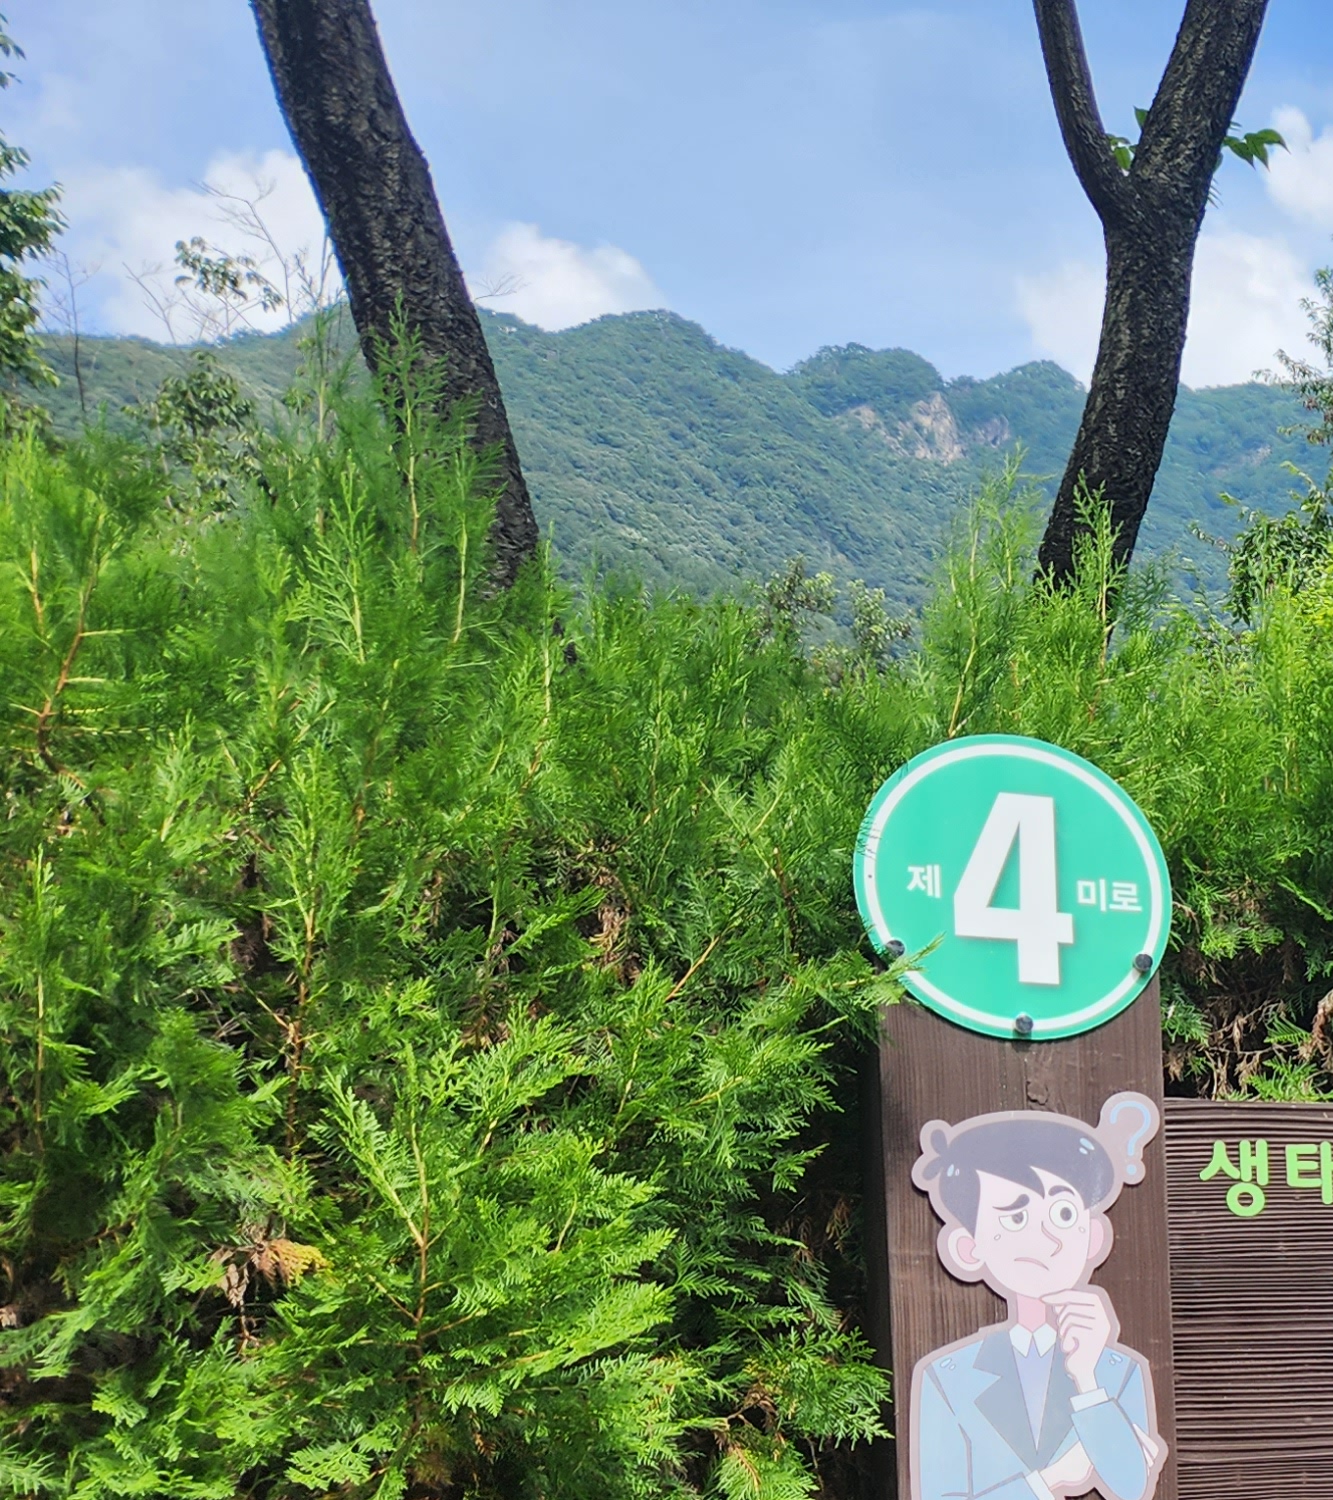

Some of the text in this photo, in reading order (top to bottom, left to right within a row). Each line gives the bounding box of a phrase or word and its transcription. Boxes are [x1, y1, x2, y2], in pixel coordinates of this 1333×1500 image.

[906, 791, 1142, 985] 제 4 미로
